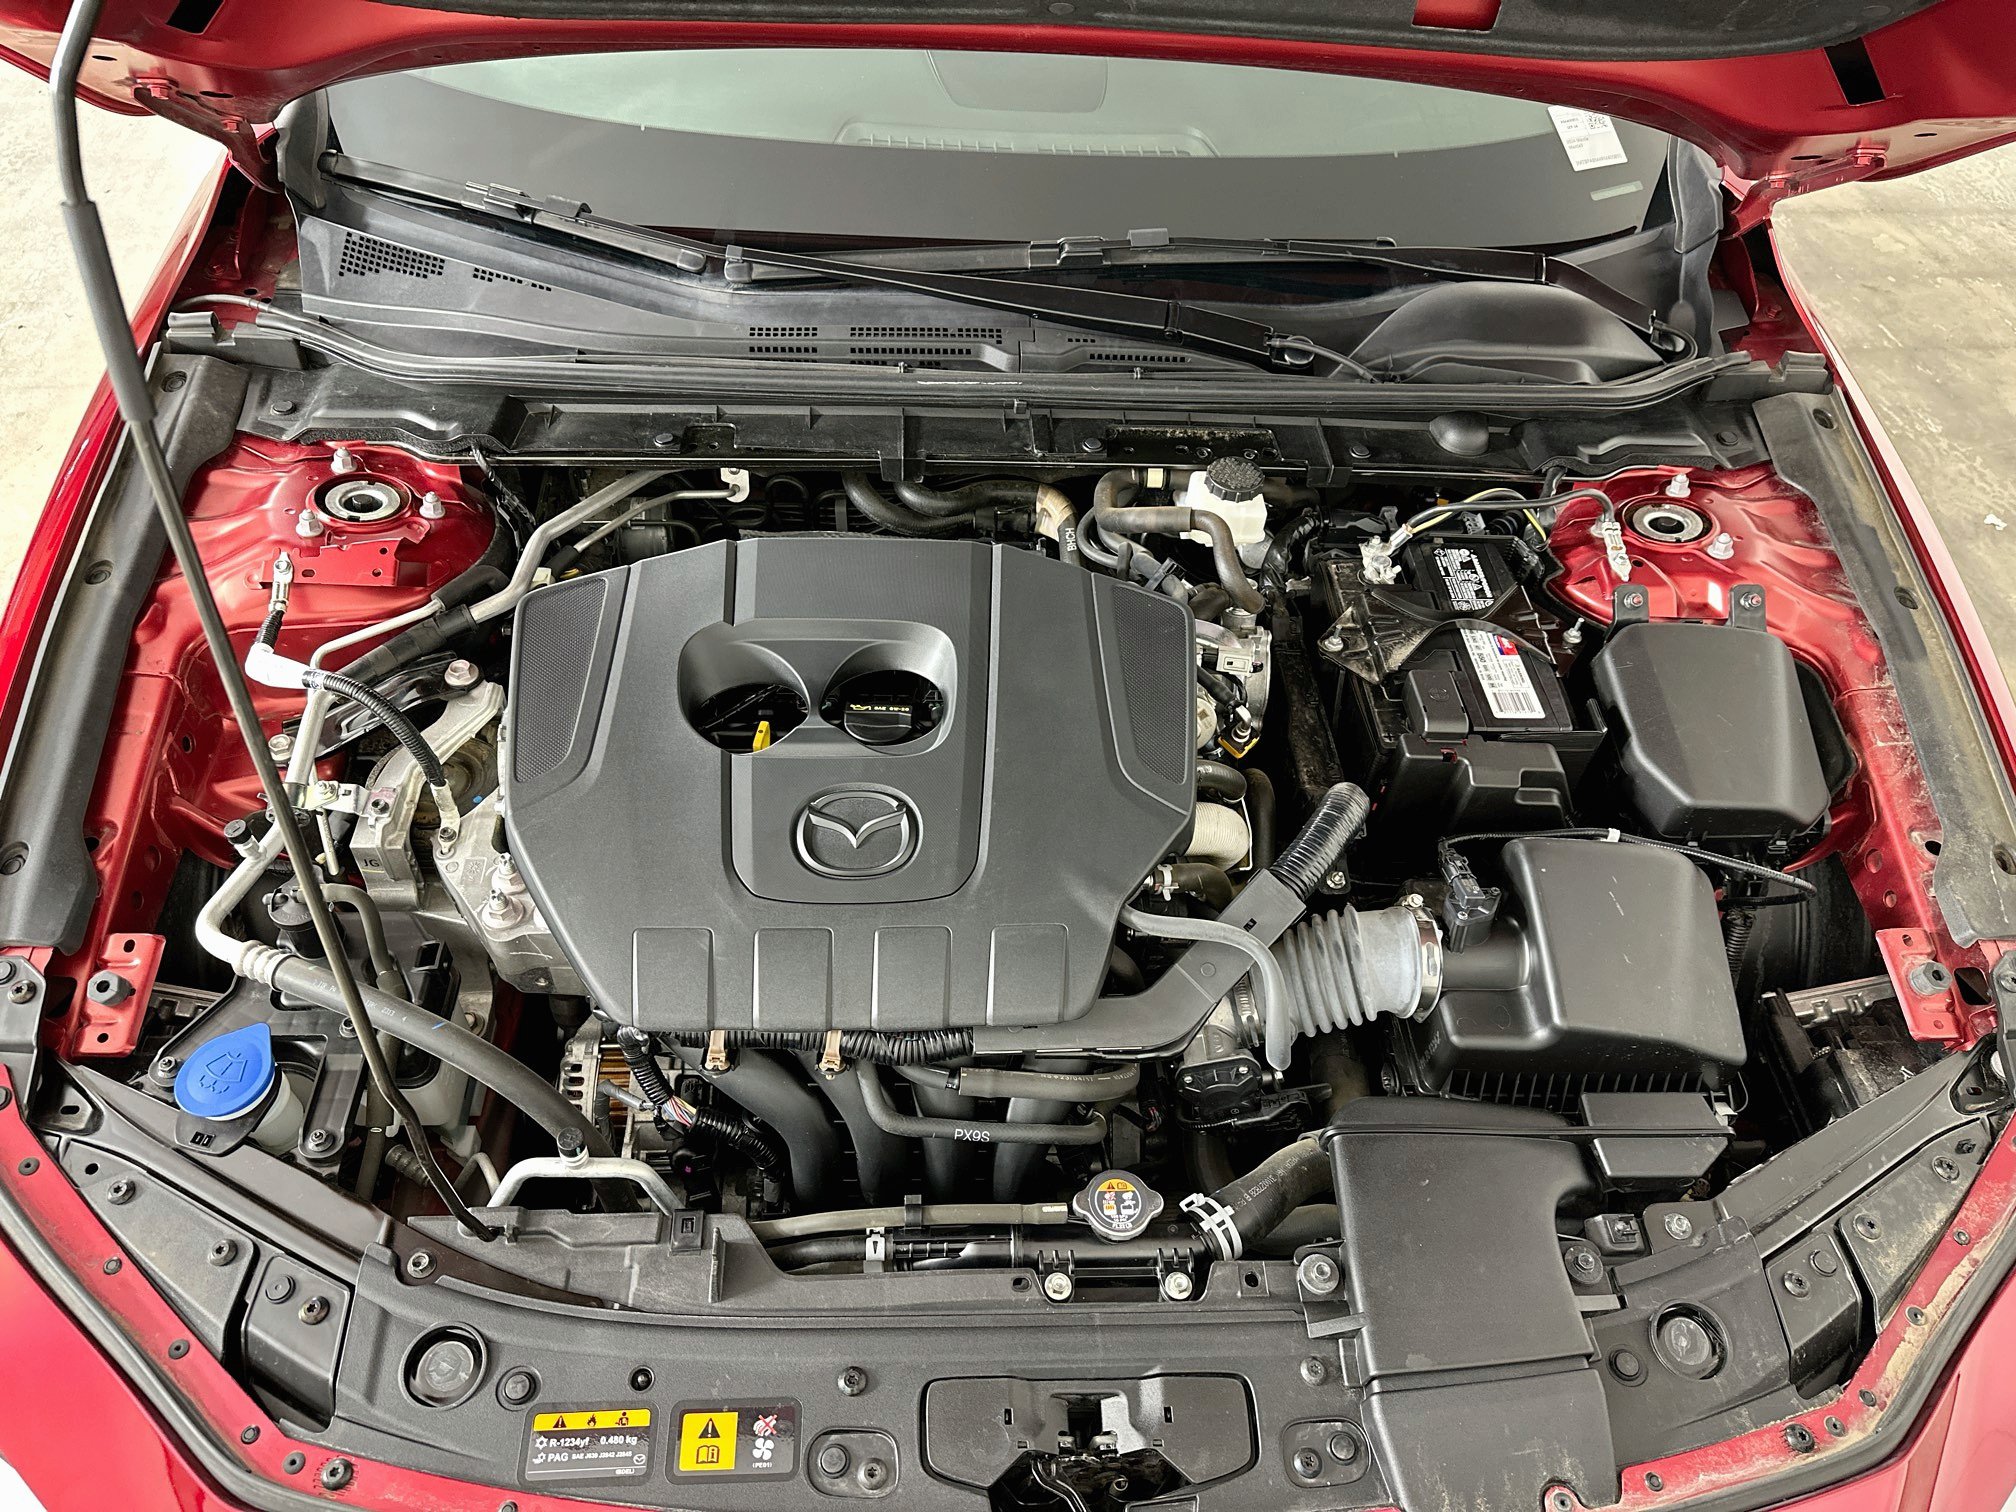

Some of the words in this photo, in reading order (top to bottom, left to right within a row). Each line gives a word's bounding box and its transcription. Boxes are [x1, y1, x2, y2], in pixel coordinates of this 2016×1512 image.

[1065, 527, 1077, 551] BHCH
[954, 1128, 990, 1143] PX9S
[549, 1436, 590, 1448] R-1234yf
[600, 1435, 624, 1445] 0.480
[625, 1435, 638, 1445] kg
[547, 1452, 569, 1462] PAG
